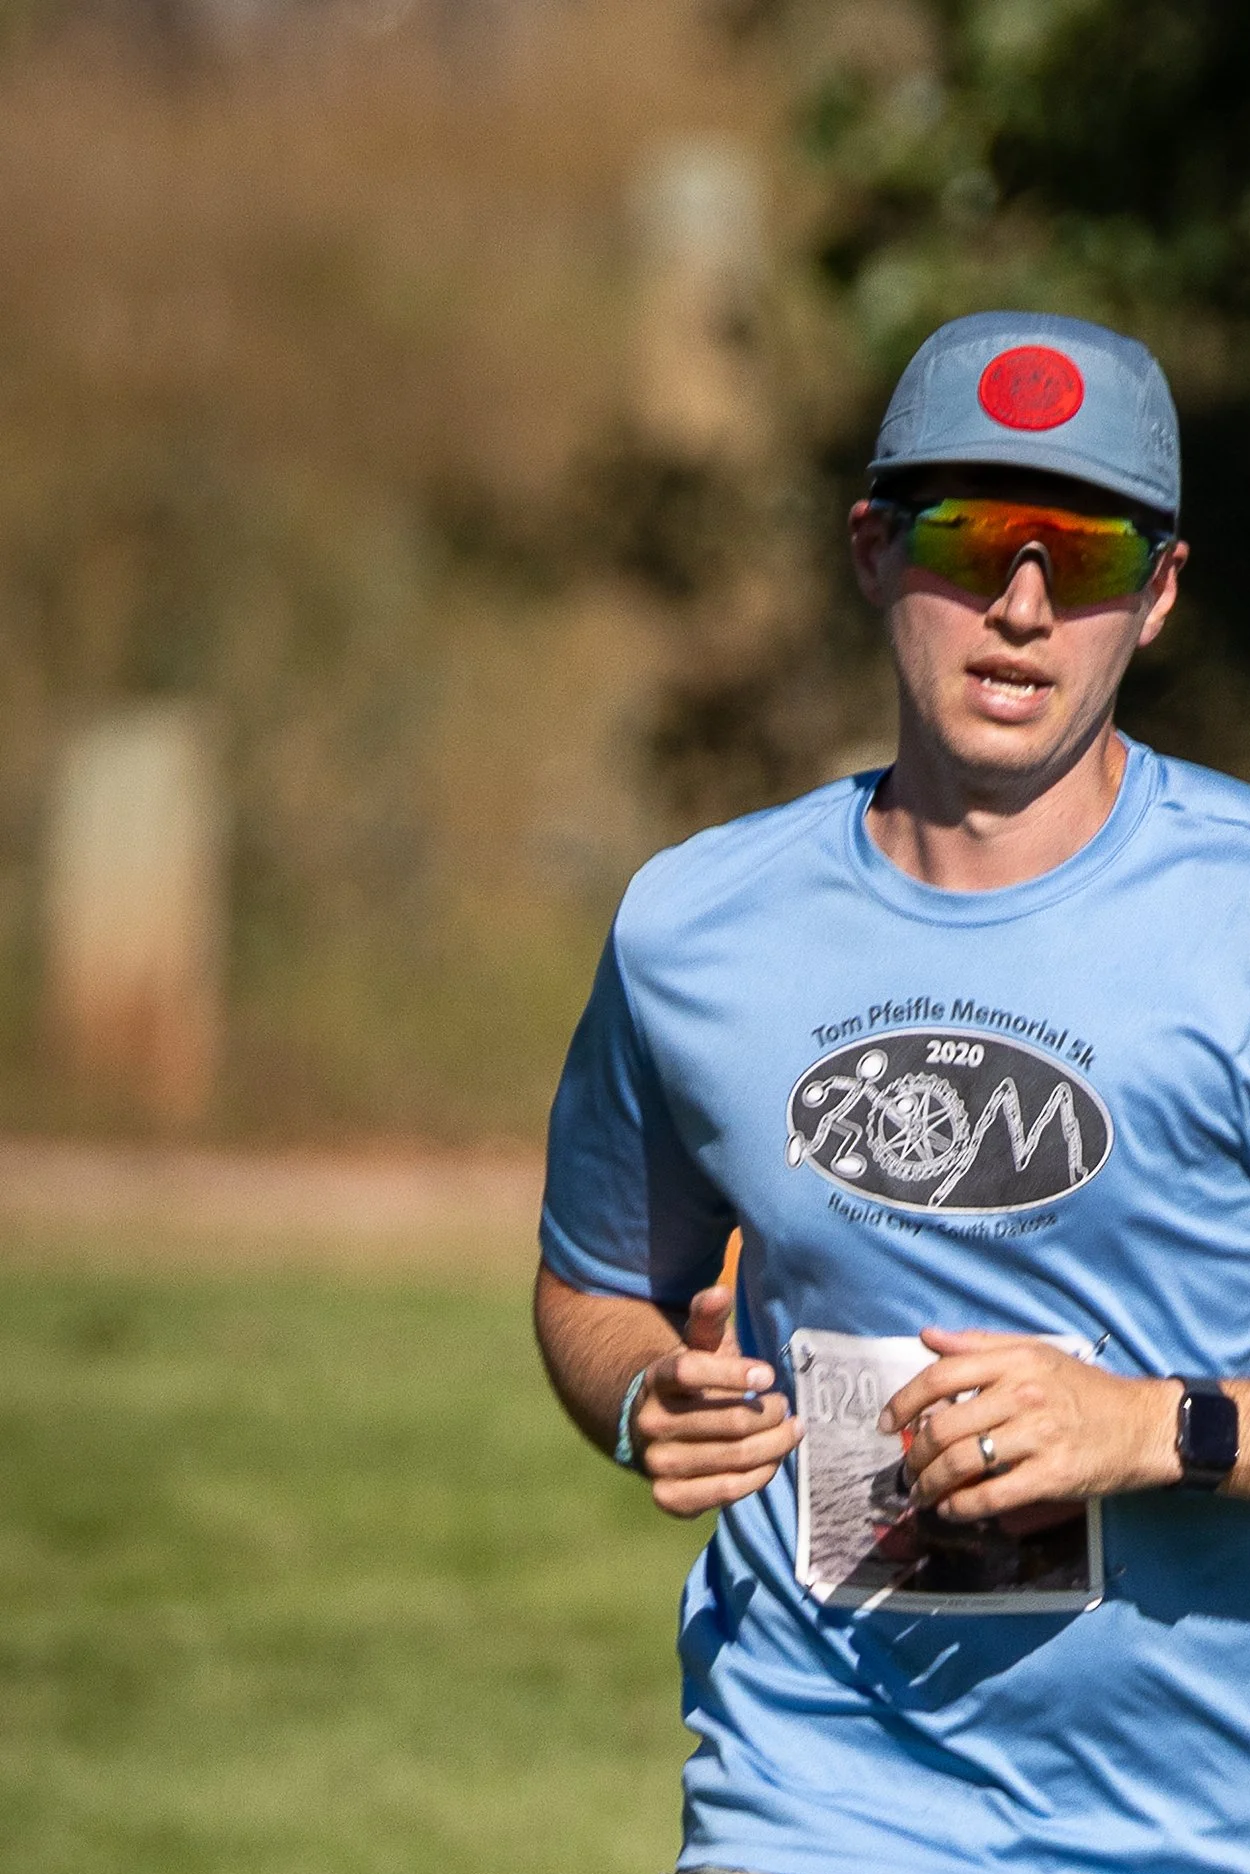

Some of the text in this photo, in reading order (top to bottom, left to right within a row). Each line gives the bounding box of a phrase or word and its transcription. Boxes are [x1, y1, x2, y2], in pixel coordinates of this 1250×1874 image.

[811, 1015, 862, 1047] Tom
[868, 997, 945, 1028] Pfeifle
[950, 998, 1069, 1052] Memorial
[926, 1039, 985, 1068] 2020
